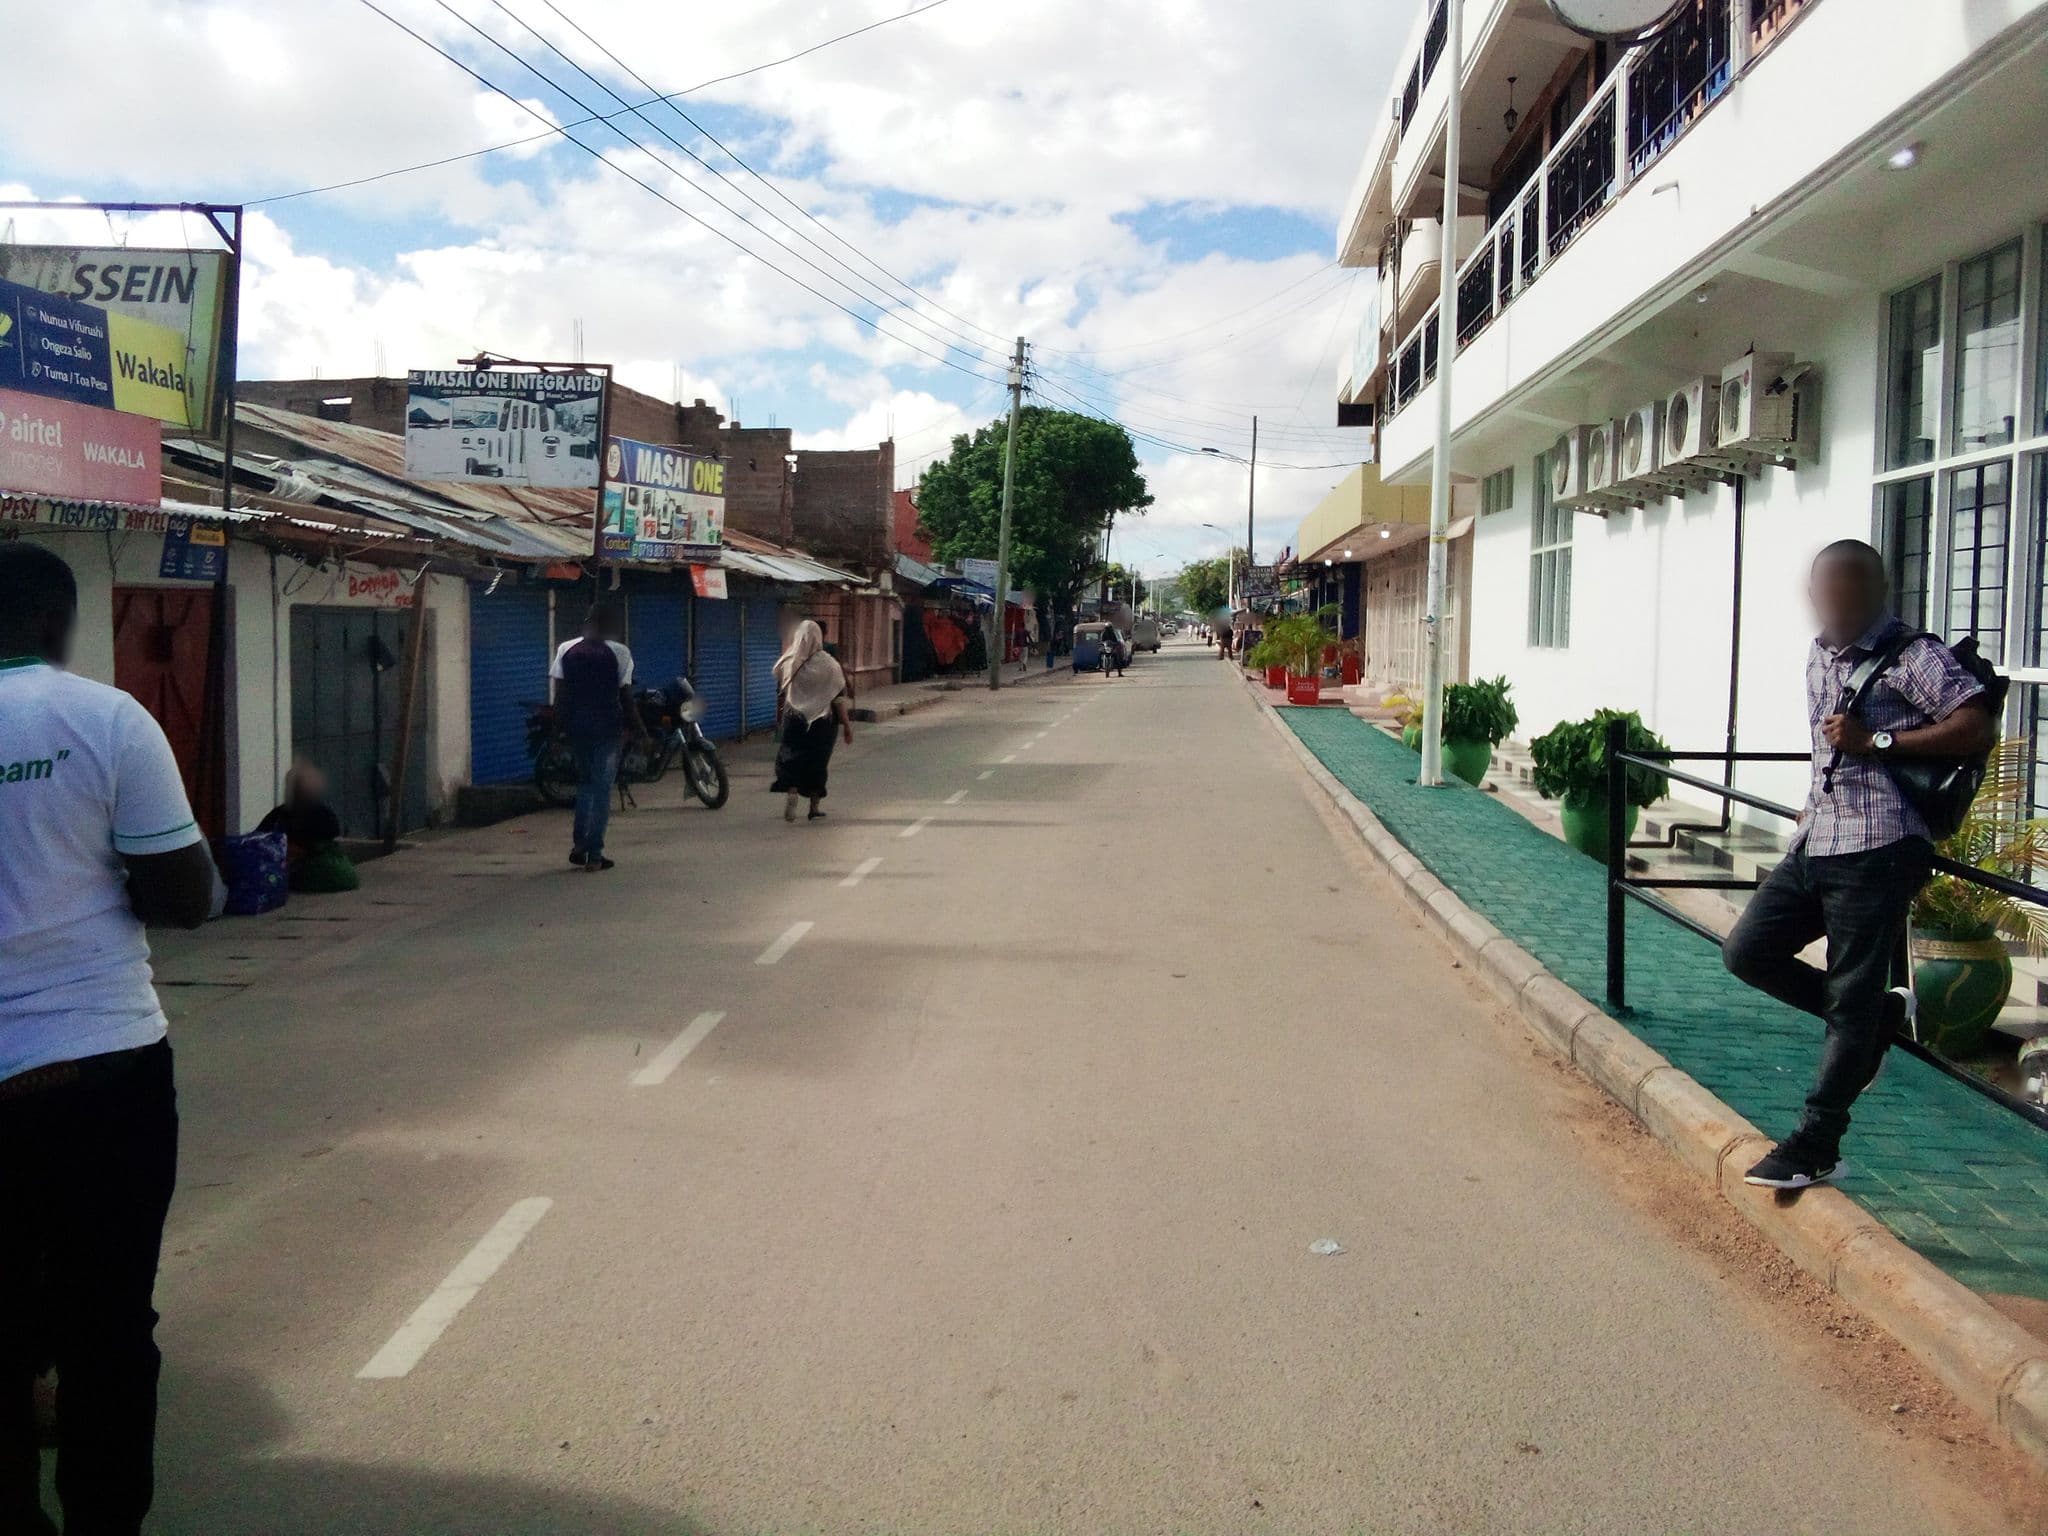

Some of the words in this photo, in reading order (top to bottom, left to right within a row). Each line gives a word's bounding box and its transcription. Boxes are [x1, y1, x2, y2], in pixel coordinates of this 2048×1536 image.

[40, 310, 68, 329] Nunua
[41, 337, 73, 356] Ongeza
[73, 345, 92, 360] Salio
[43, 365, 69, 382] Tuma
[74, 373, 90, 387] Toa
[90, 376, 108, 391] Pesa
[115, 350, 187, 394] Wakala
[423, 370, 472, 388] MASAI
[475, 372, 508, 389] ONE
[511, 374, 602, 392] INTEGRATED
[11, 413, 63, 447] airtel
[83, 441, 146, 469] WAKALA
[636, 448, 690, 489] MASAI
[693, 460, 725, 495] ONE
